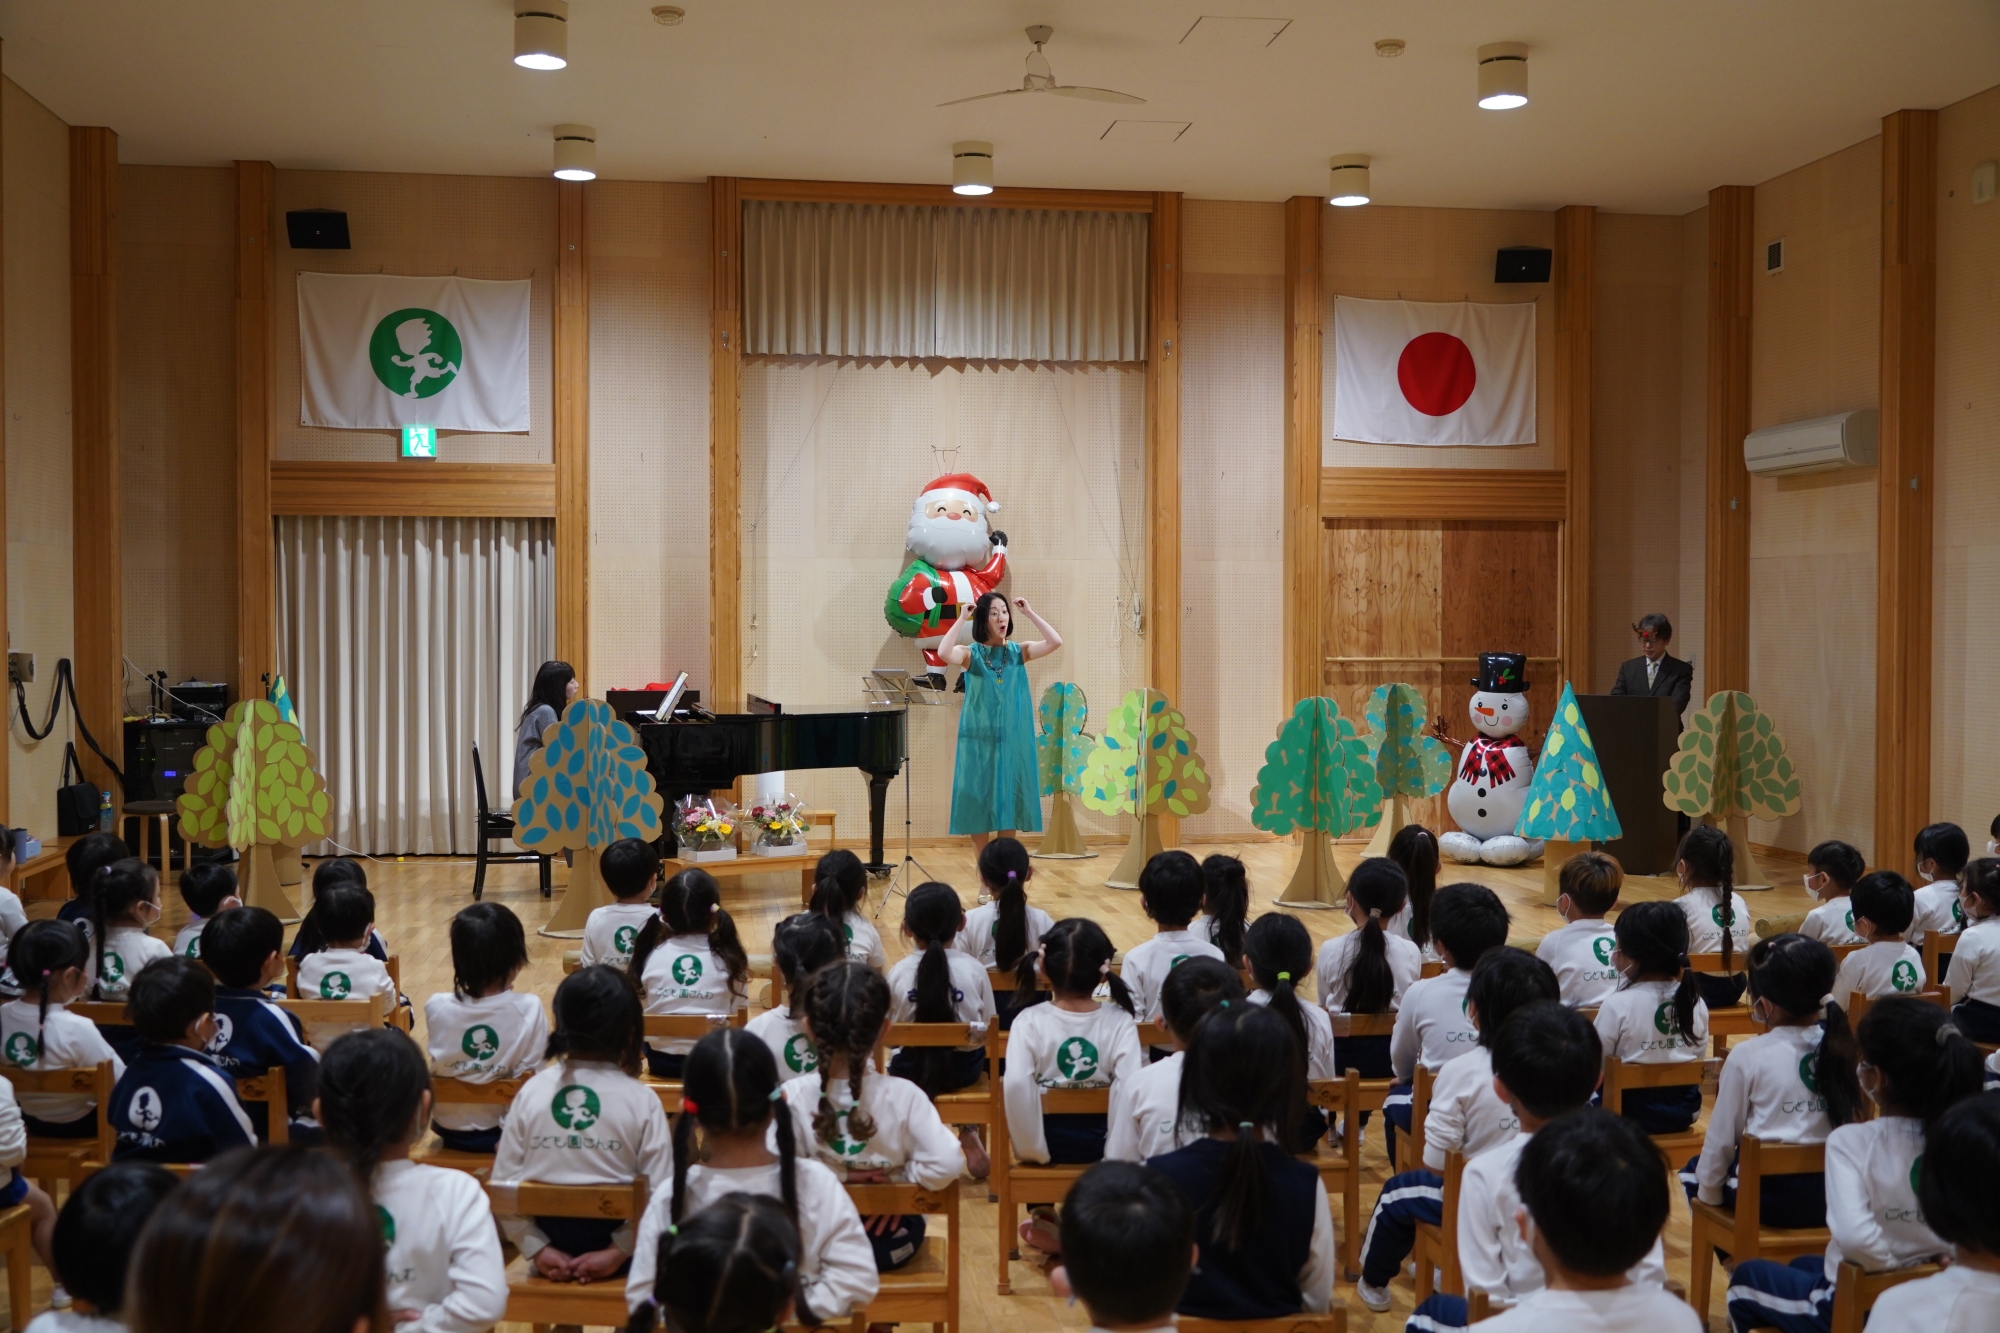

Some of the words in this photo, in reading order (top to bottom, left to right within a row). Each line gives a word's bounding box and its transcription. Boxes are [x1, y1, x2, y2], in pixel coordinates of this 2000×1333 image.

[1702, 930, 1747, 940] こどもさんわ
[1583, 969, 1618, 981] こども園
[655, 987, 714, 999] こども園さんわ
[1782, 1099, 1828, 1113] こども園
[530, 1135, 622, 1151] こども園さんわ
